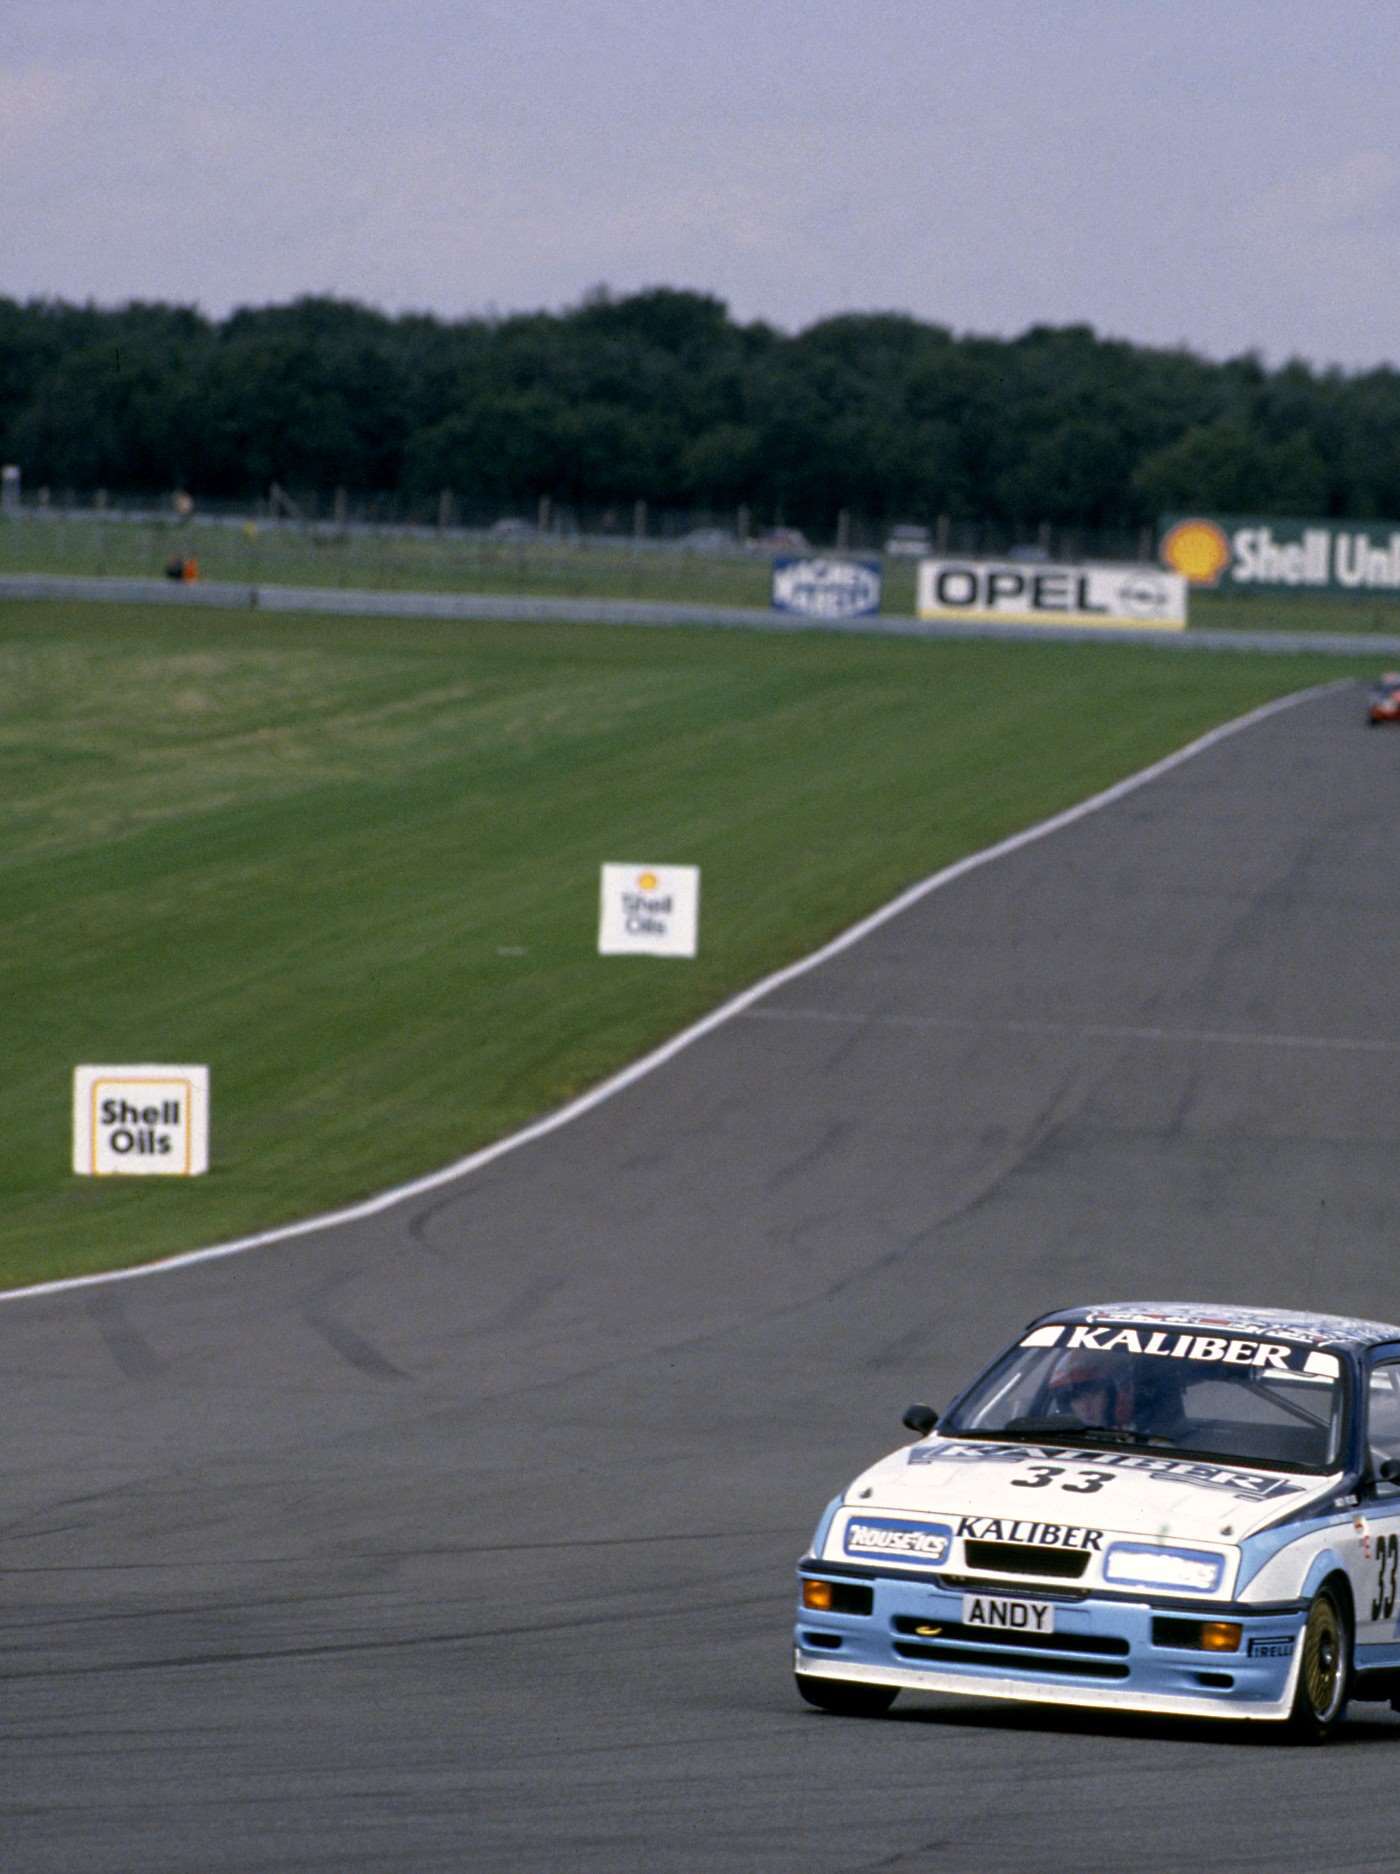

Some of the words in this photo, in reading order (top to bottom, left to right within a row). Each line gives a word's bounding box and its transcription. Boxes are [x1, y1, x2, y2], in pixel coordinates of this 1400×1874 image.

[1231, 526, 1331, 586] Shell
[935, 568, 1110, 615] OPEL
[101, 1098, 179, 1125] Shell
[110, 1128, 172, 1155] Oils
[1066, 1325, 1293, 1370] KALIBER
[938, 1443, 1268, 1493] KALIBER
[1010, 1465, 1116, 1494] 33
[955, 1516, 1105, 1552] KALIBER
[1371, 1534, 1398, 1621] 33
[968, 1599, 1049, 1631] ANDY
